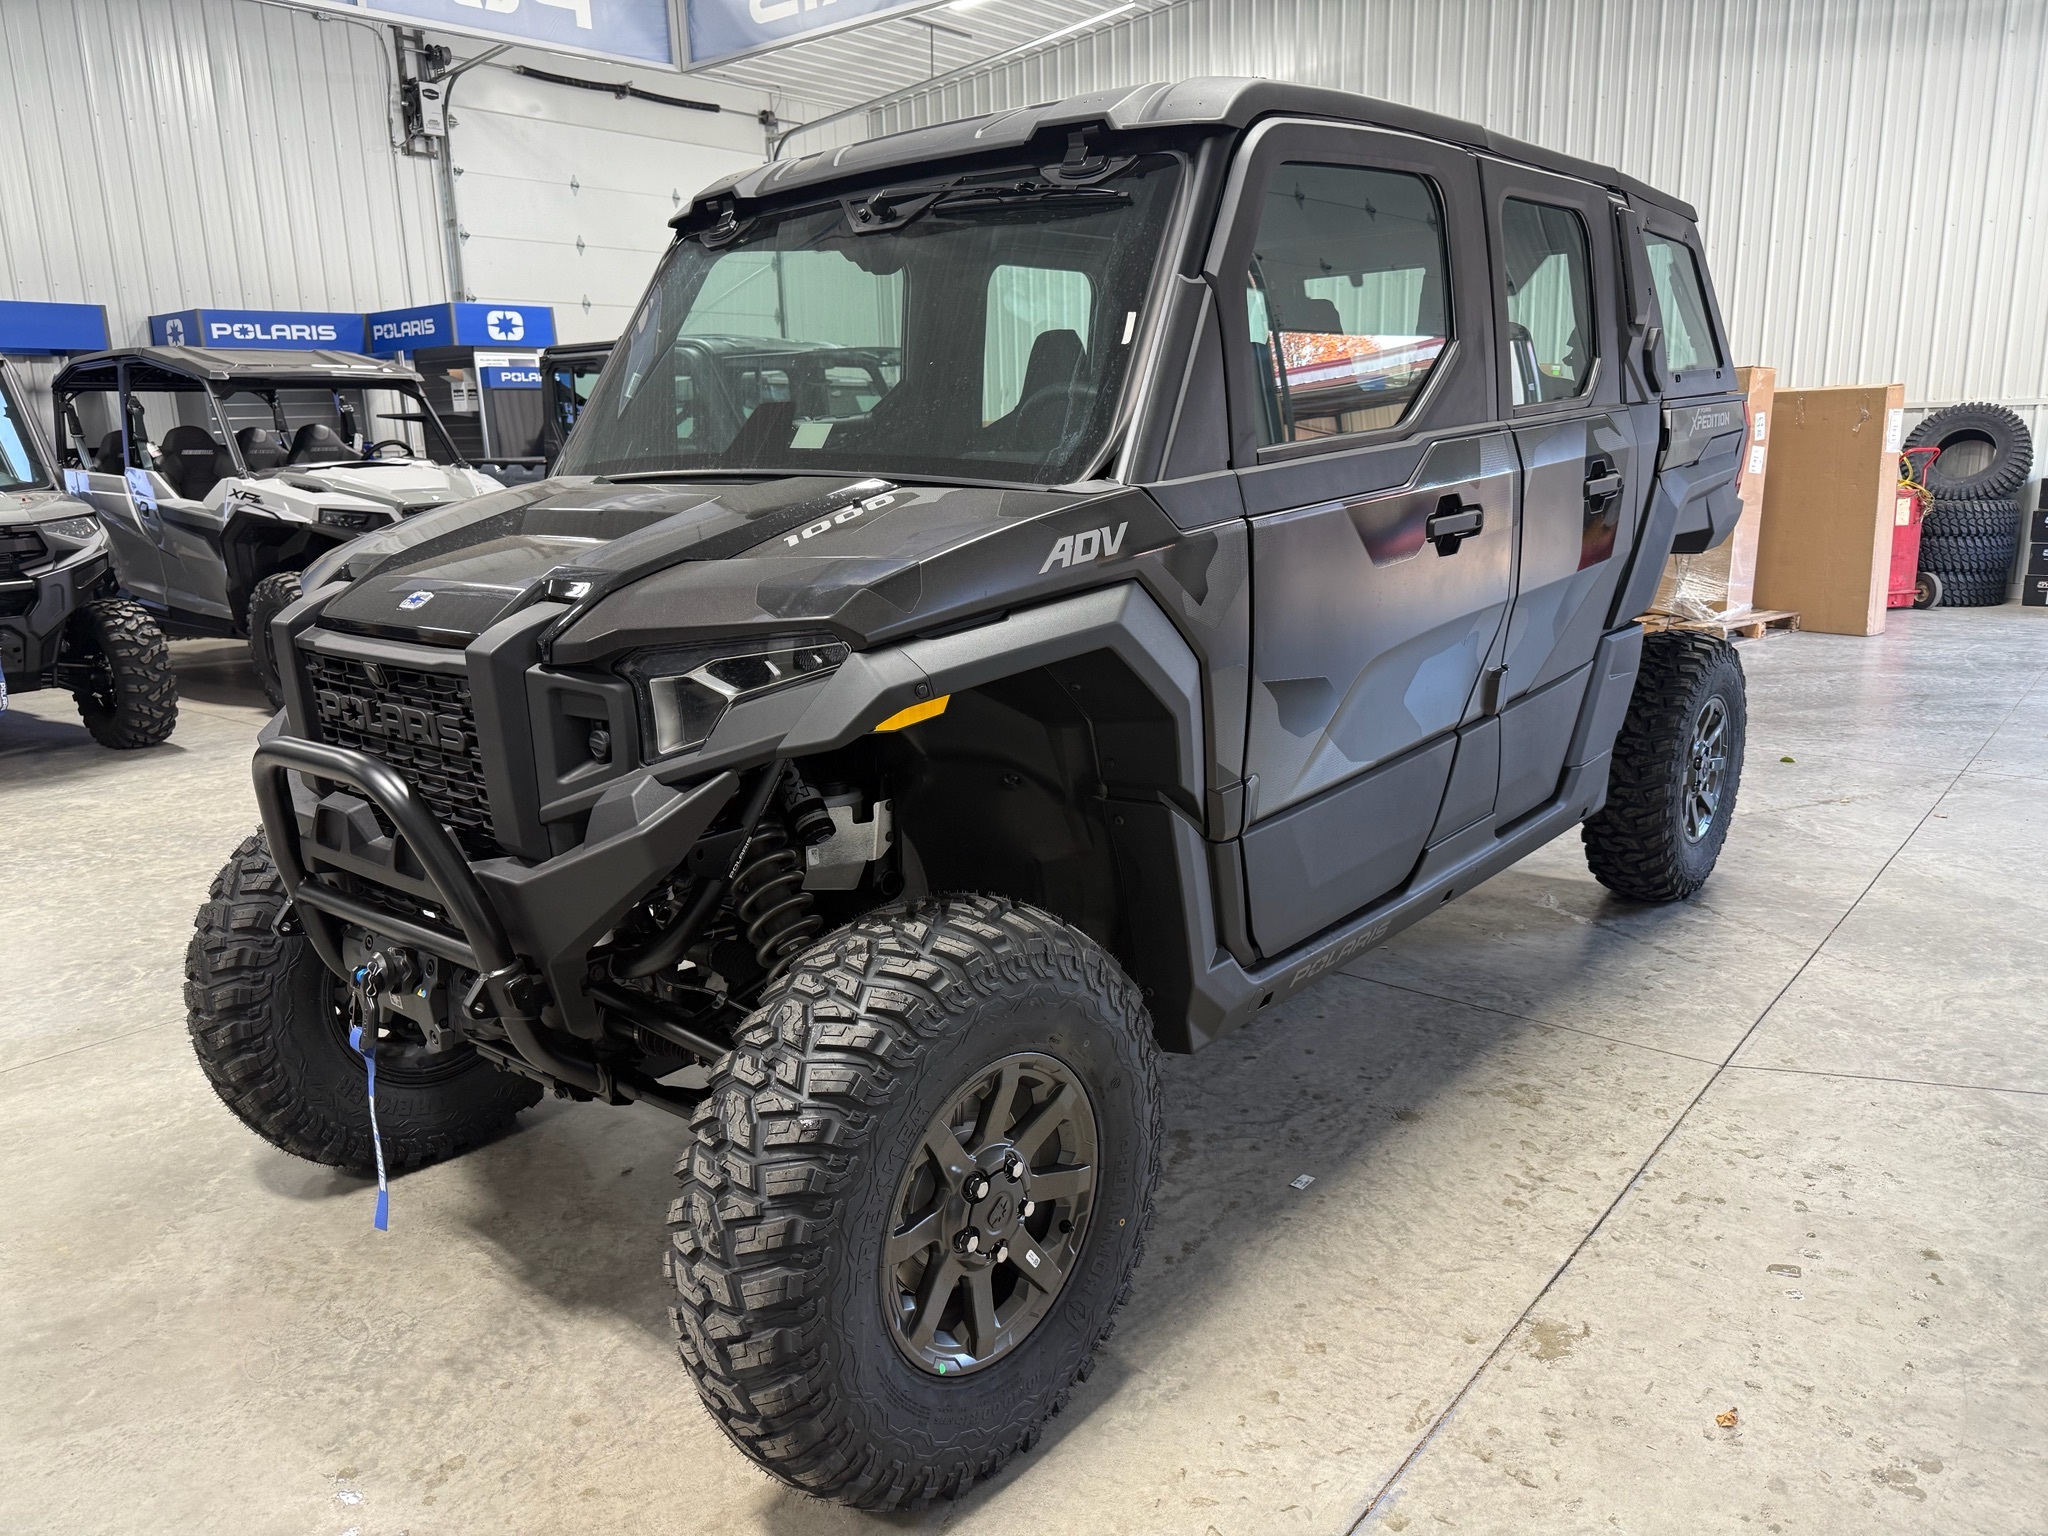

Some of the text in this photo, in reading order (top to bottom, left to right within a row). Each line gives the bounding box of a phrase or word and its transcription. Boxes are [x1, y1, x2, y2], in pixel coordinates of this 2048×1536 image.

[210, 323, 337, 341] POLARIS
[373, 318, 436, 340] POLARIS
[501, 372, 560, 382] POLAS
[1689, 408, 1730, 437] XPEDITION
[783, 494, 896, 547] 1000
[1038, 521, 1129, 575] ADV
[318, 689, 466, 752] POLARIS
[729, 836, 752, 879] POLARIS
[1289, 920, 1391, 988] POLARIS
